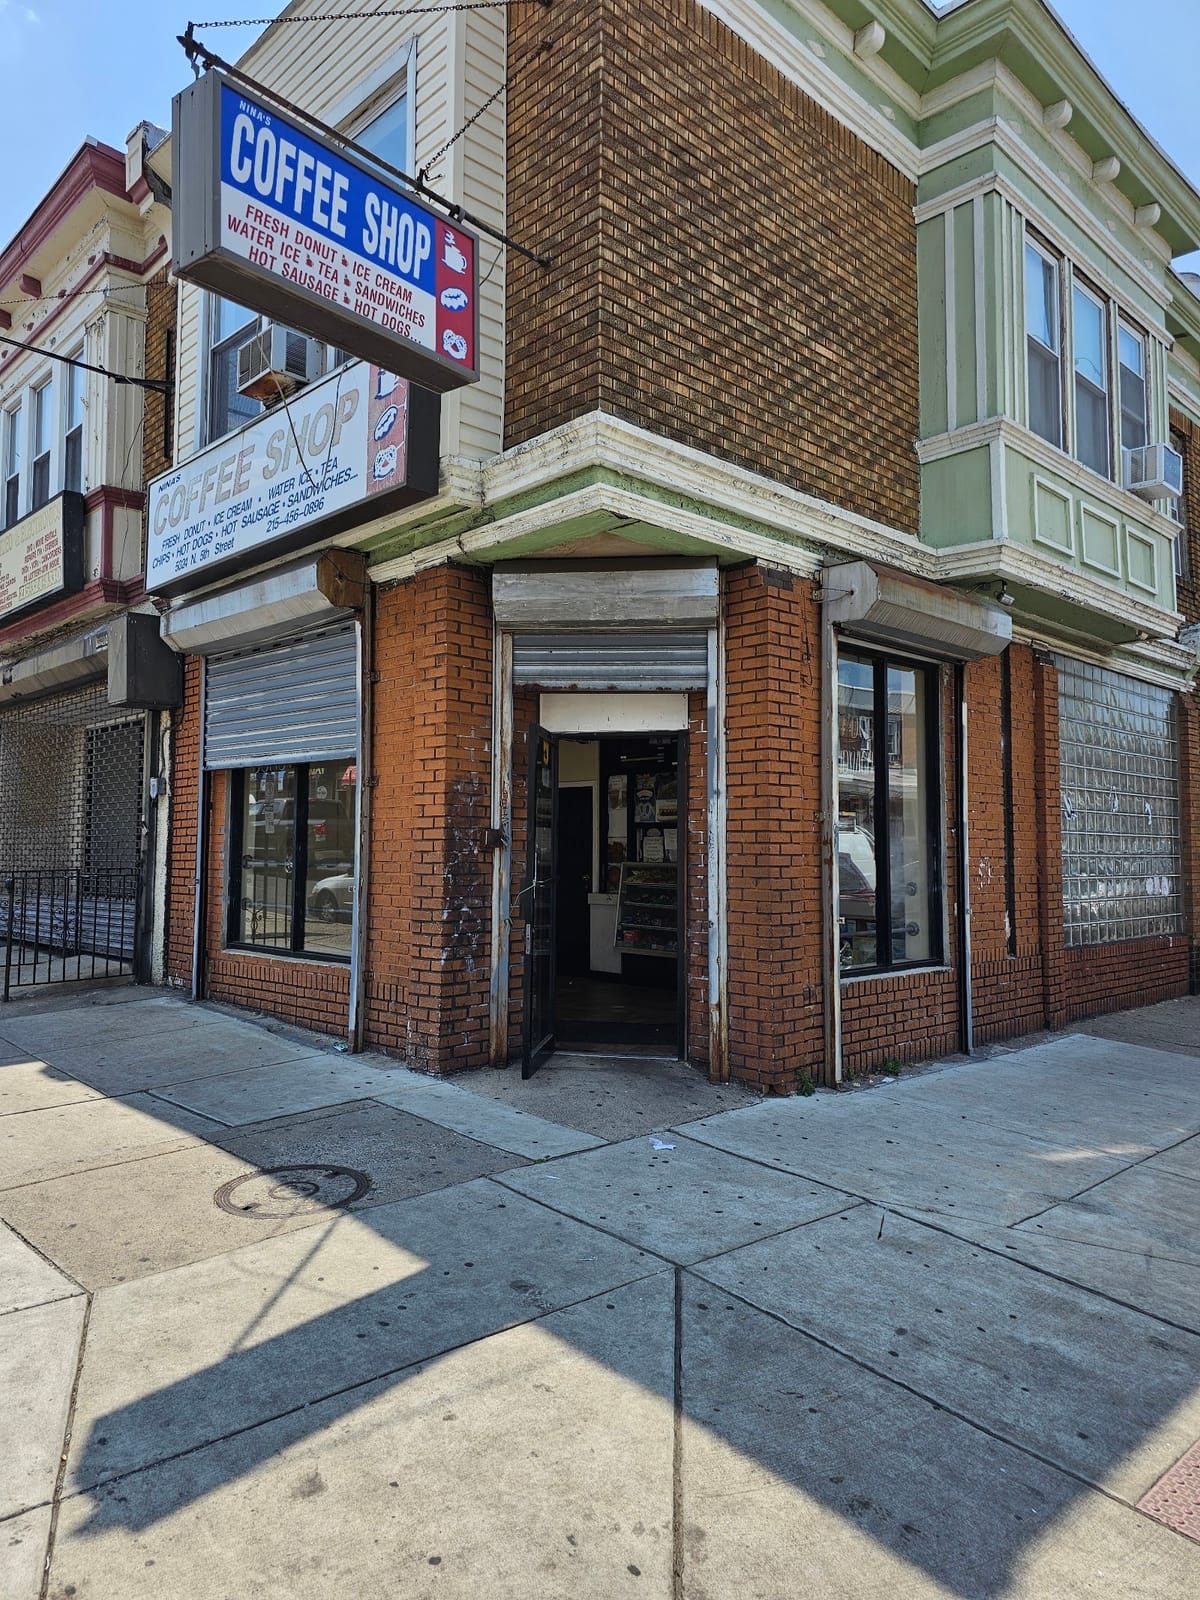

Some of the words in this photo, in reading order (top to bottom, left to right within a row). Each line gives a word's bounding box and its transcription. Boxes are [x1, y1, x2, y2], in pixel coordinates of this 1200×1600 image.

[239, 100, 272, 126] NINA'S
[230, 113, 349, 239] COFFEE
[362, 192, 431, 280] SHOP
[228, 214, 275, 251] WATER
[280, 242, 302, 264] ICE
[318, 260, 339, 284] TEA
[354, 281, 426, 328] SANDWICHES
[245, 204, 290, 239] FRESH
[294, 230, 338, 263] DONUT
[352, 261, 371, 282] ICE
[375, 273, 413, 304] CREAM
[248, 245, 278, 271] HOT
[281, 262, 340, 302] SAUSAGE
[354, 299, 378, 321] HOT
[153, 444, 256, 537] COFFEE
[262, 388, 360, 480] SHOP
[161, 532, 181, 552] FRESH
[183, 519, 206, 540] DONUT
[213, 510, 225, 527] ICE
[226, 496, 253, 521] CREAM
[268, 476, 296, 501] WATER
[298, 467, 313, 487] ICE
[320, 456, 338, 477] TEA
[152, 551, 171, 569] CHIPS
[176, 541, 192, 559] HOT
[191, 531, 214, 552] DOGS
[220, 519, 239, 538] HOT
[241, 500, 281, 529] SAUSAGE
[214, 536, 235, 555] Street
[265, 497, 326, 533] 215-456-0896
